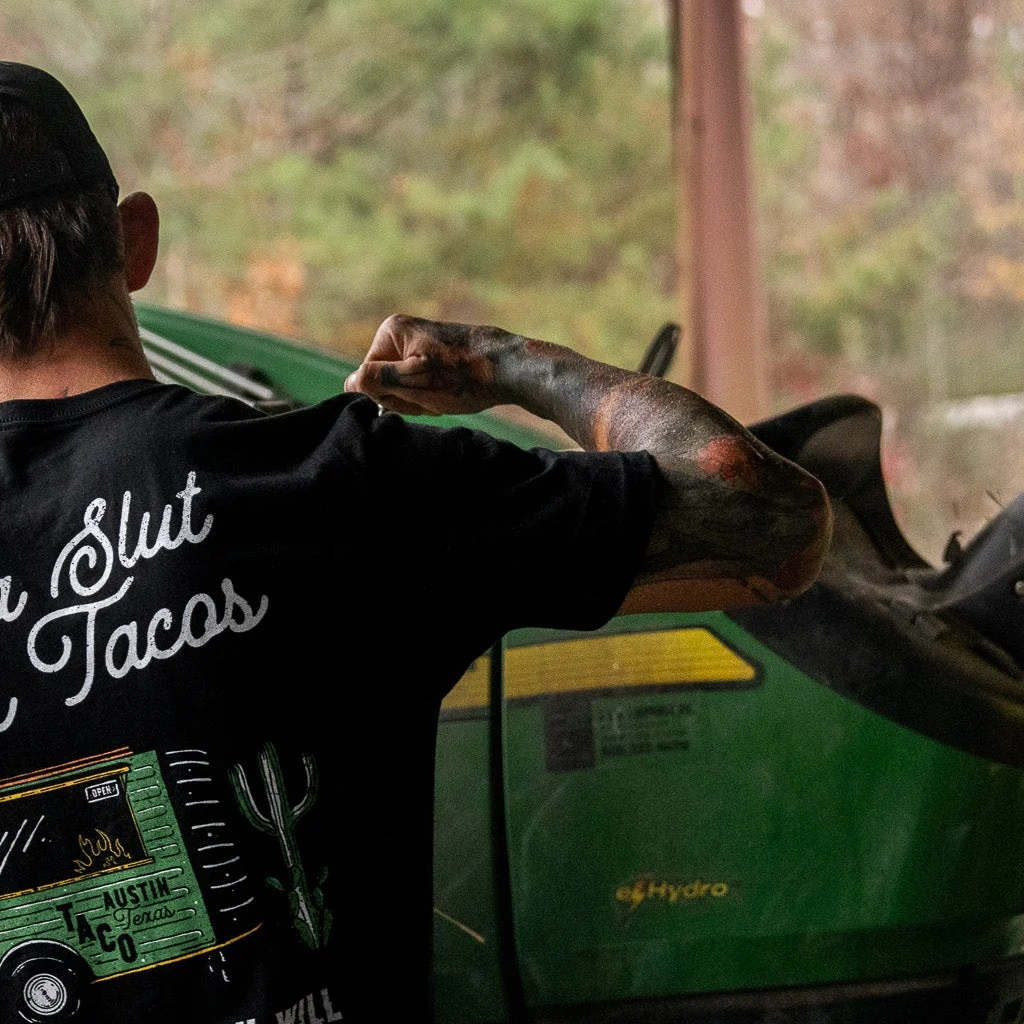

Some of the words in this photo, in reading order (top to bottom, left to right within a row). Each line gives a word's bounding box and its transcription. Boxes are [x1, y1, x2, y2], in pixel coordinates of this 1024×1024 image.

[50, 470, 215, 597] Slut
[26, 576, 269, 706] Tacos
[91, 784, 113, 798] OPEN
[102, 876, 172, 911] AUSTIN
[113, 906, 176, 929] Texas
[56, 903, 138, 964] TACO
